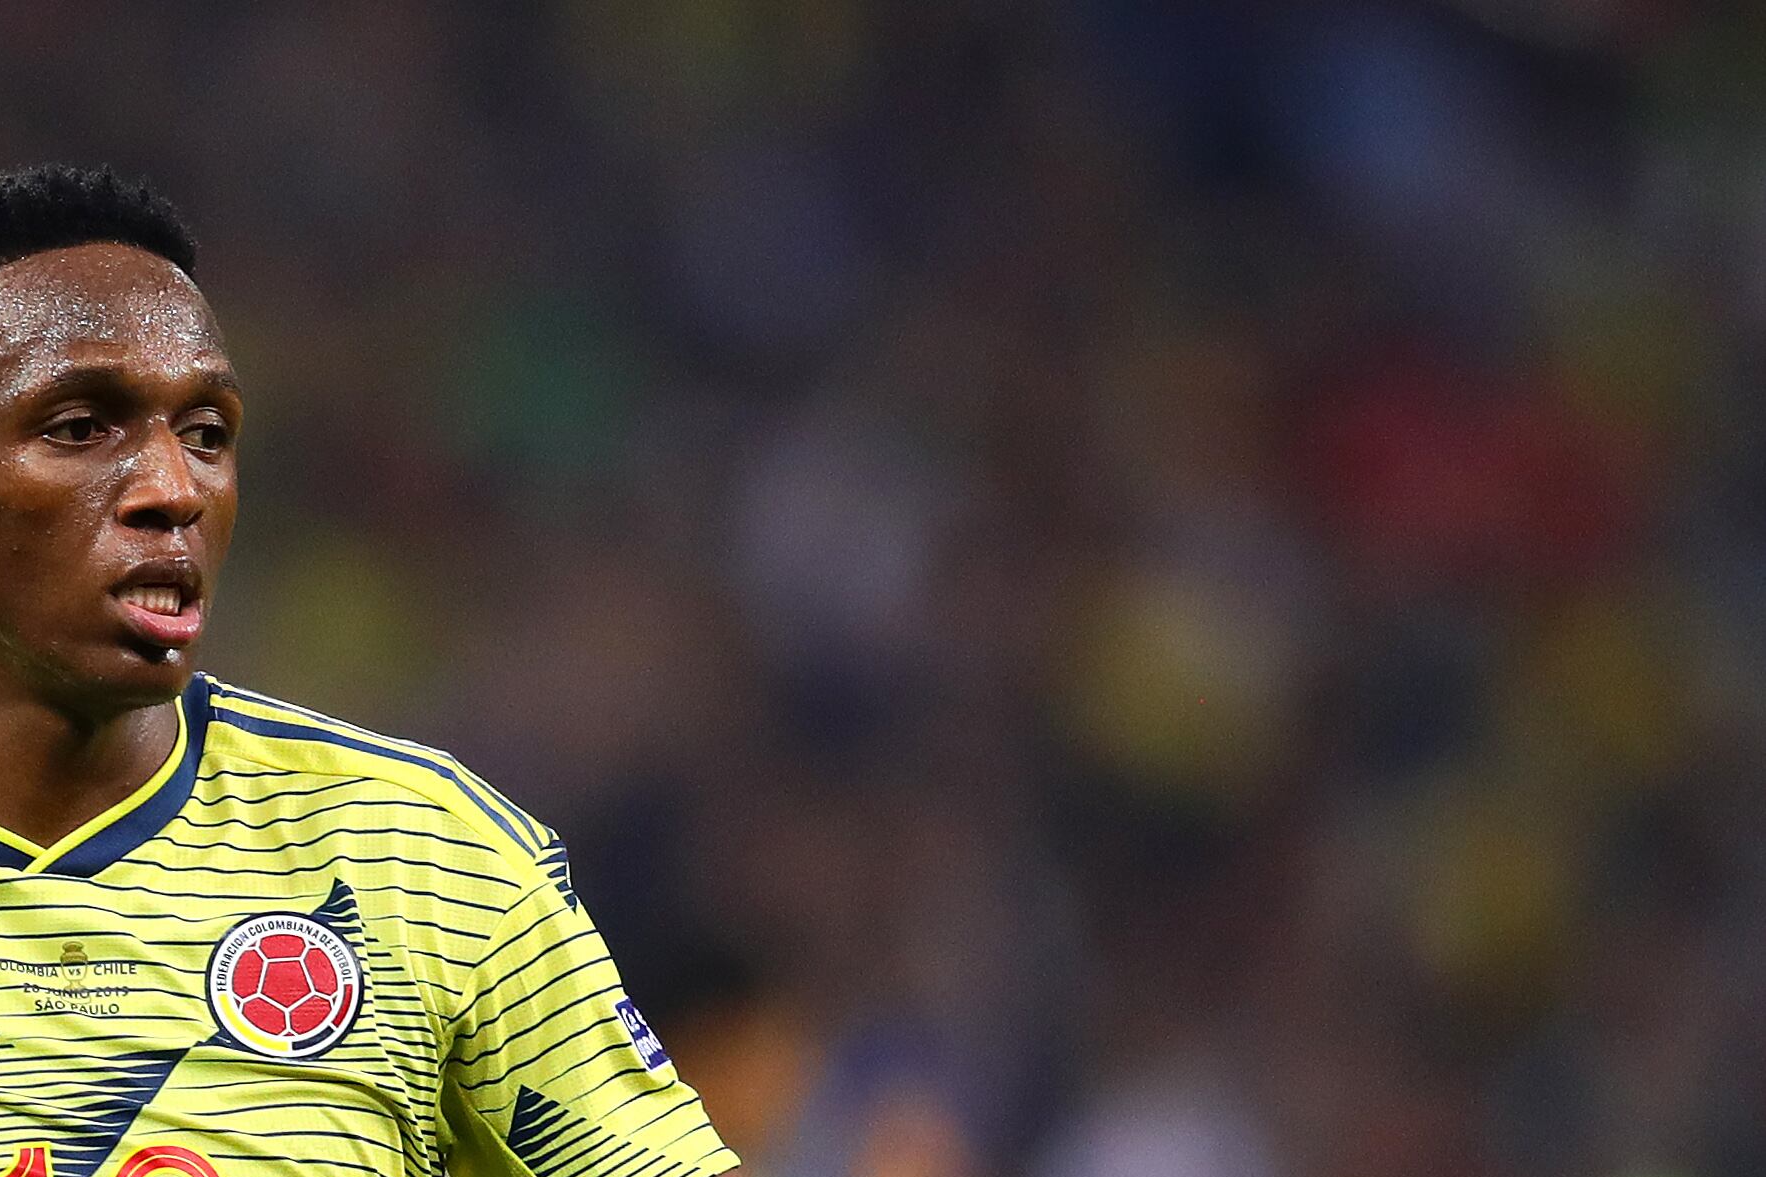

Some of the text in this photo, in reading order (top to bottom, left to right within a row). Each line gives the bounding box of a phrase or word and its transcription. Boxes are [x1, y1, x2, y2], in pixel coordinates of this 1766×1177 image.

[248, 920, 319, 937] COLOMBIANA
[320, 934, 334, 948] DE
[93, 963, 138, 976] CHILE
[35, 997, 120, 1015] SÃO PAULO
